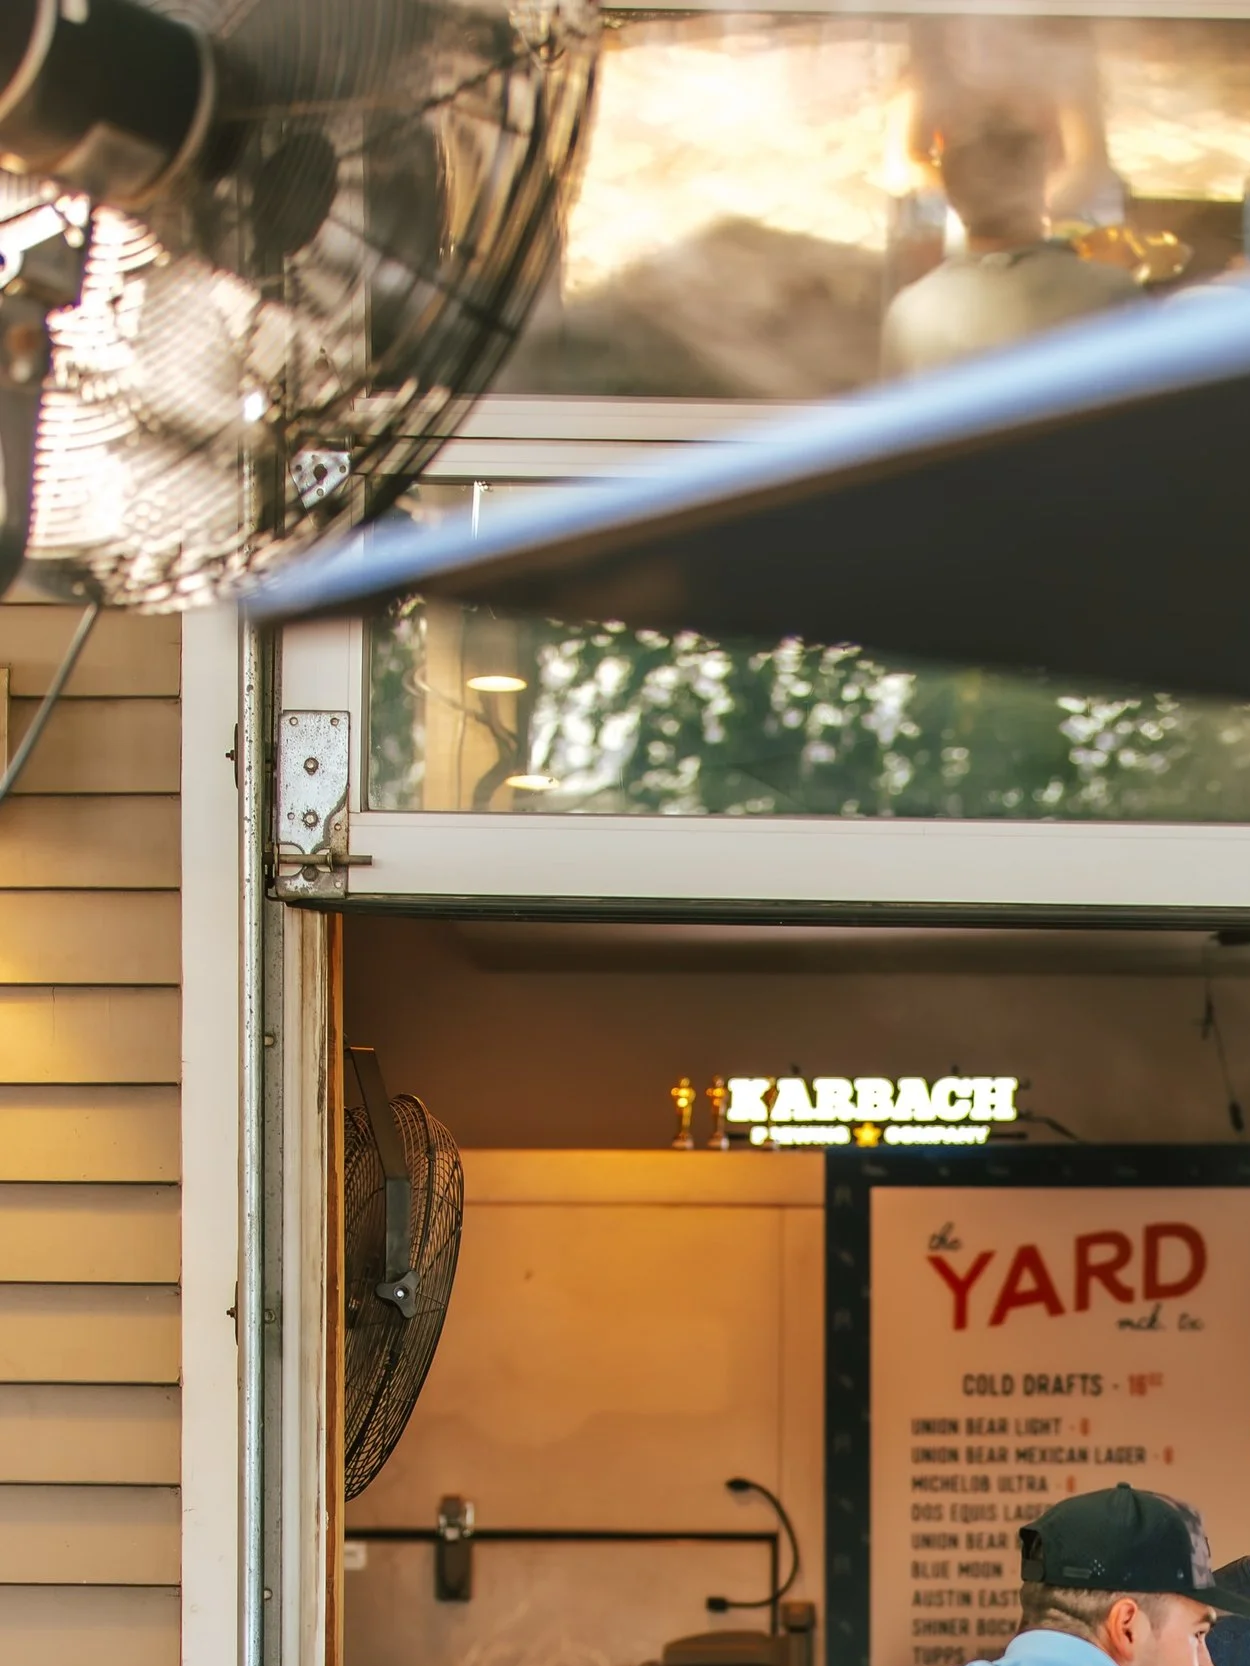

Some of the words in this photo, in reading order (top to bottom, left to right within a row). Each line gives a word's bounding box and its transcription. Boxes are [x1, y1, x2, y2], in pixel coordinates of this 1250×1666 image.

[726, 1076, 1019, 1122] KARBACH
[928, 1221, 961, 1250] the
[926, 1221, 1207, 1331] YARD
[962, 1374, 1014, 1396] COLD
[1023, 1374, 1103, 1396] DRAFTS
[912, 1418, 959, 1436] UNION
[966, 1418, 1008, 1436] BEAR
[1015, 1418, 1062, 1436] LIGHT
[912, 1446, 959, 1465] UNION
[966, 1446, 1008, 1465] BEAR
[1015, 1446, 1088, 1465] MEXICAN
[1095, 1446, 1146, 1465] LAGER
[911, 1475, 991, 1494] MICHELOB
[997, 1475, 1049, 1494] ULTRA
[911, 1503, 943, 1521] DOS
[950, 1503, 997, 1523] EQUIS
[912, 1532, 959, 1550] UNION
[966, 1532, 1008, 1550] BEAR
[911, 1561, 950, 1579] BLUE
[957, 1561, 1003, 1579] MOON
[912, 1590, 972, 1607] AUSTIN
[912, 1618, 969, 1636] SHINER
[914, 1647, 964, 1666] TUPPS
